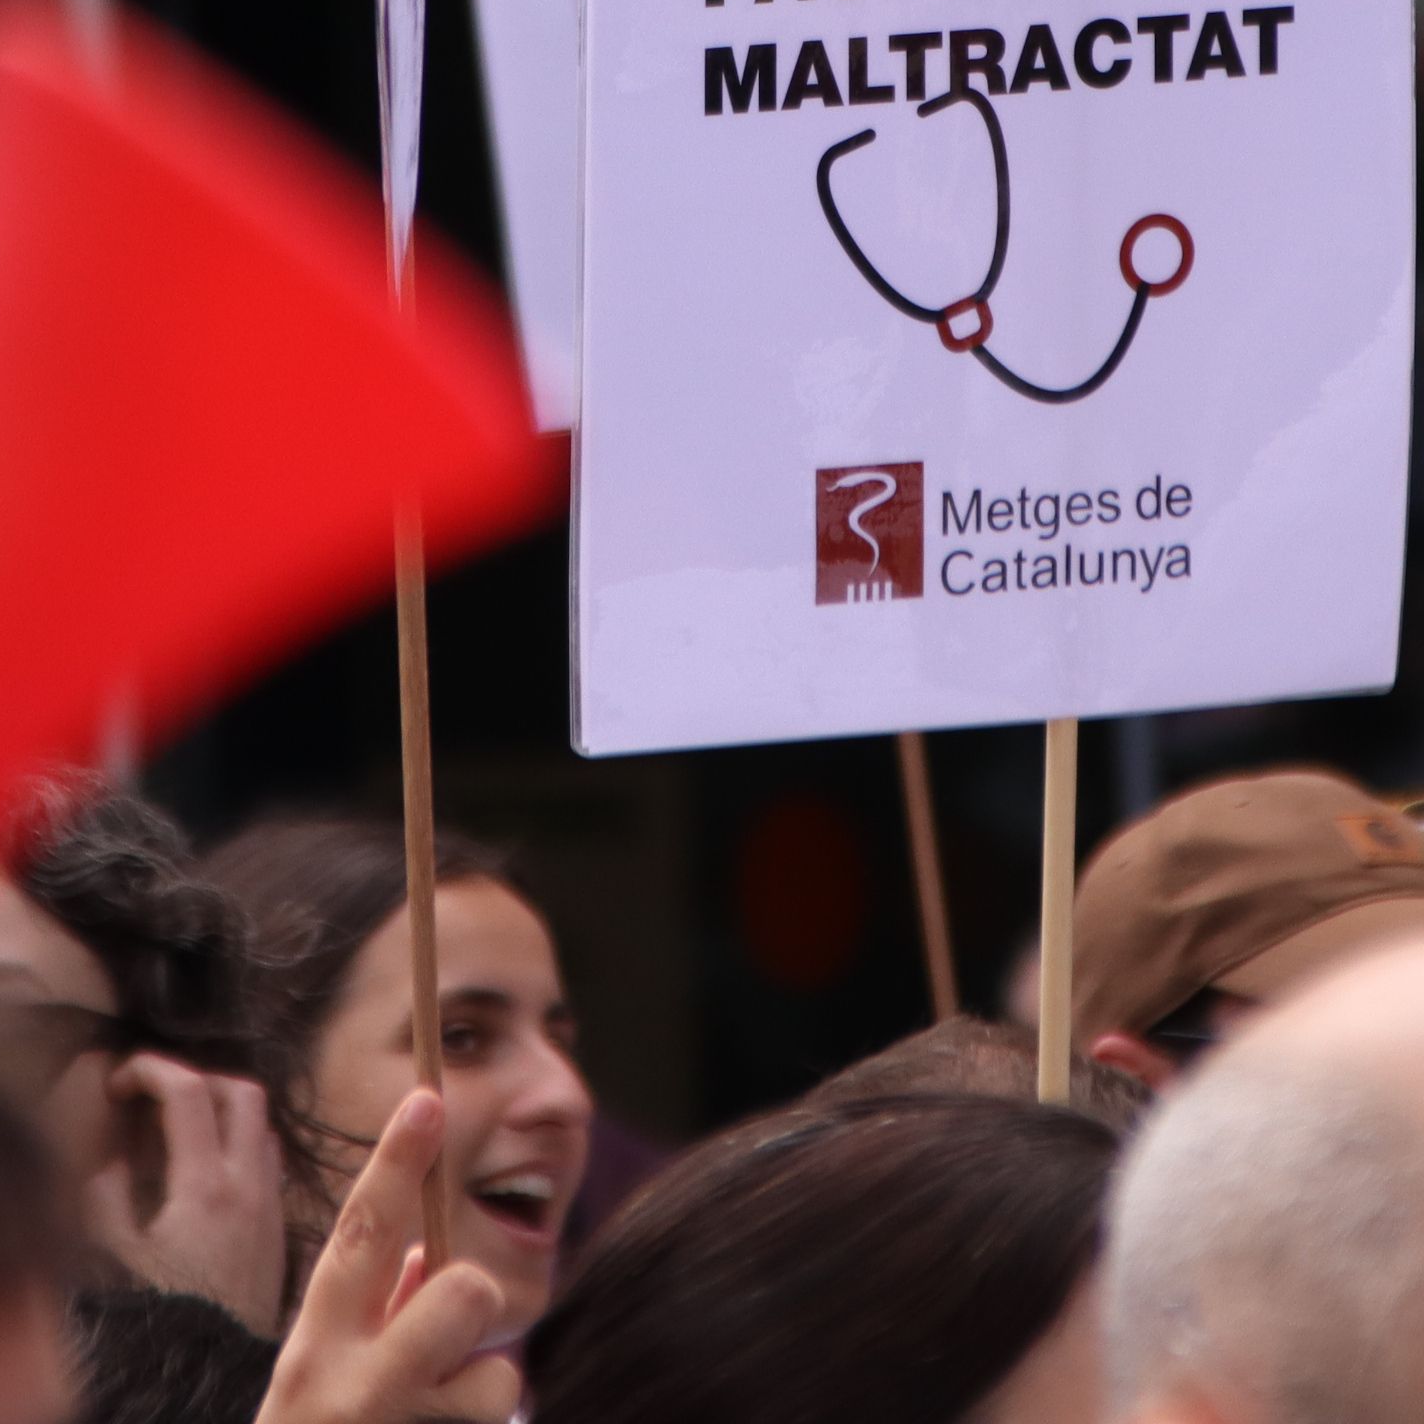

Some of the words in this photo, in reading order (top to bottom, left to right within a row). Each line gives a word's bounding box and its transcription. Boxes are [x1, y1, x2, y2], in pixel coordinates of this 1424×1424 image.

[704, 5, 1294, 116] MALTRACTAT
[941, 485, 1121, 541] Metges
[1135, 474, 1193, 520] de
[940, 543, 1193, 595] Catalunya
